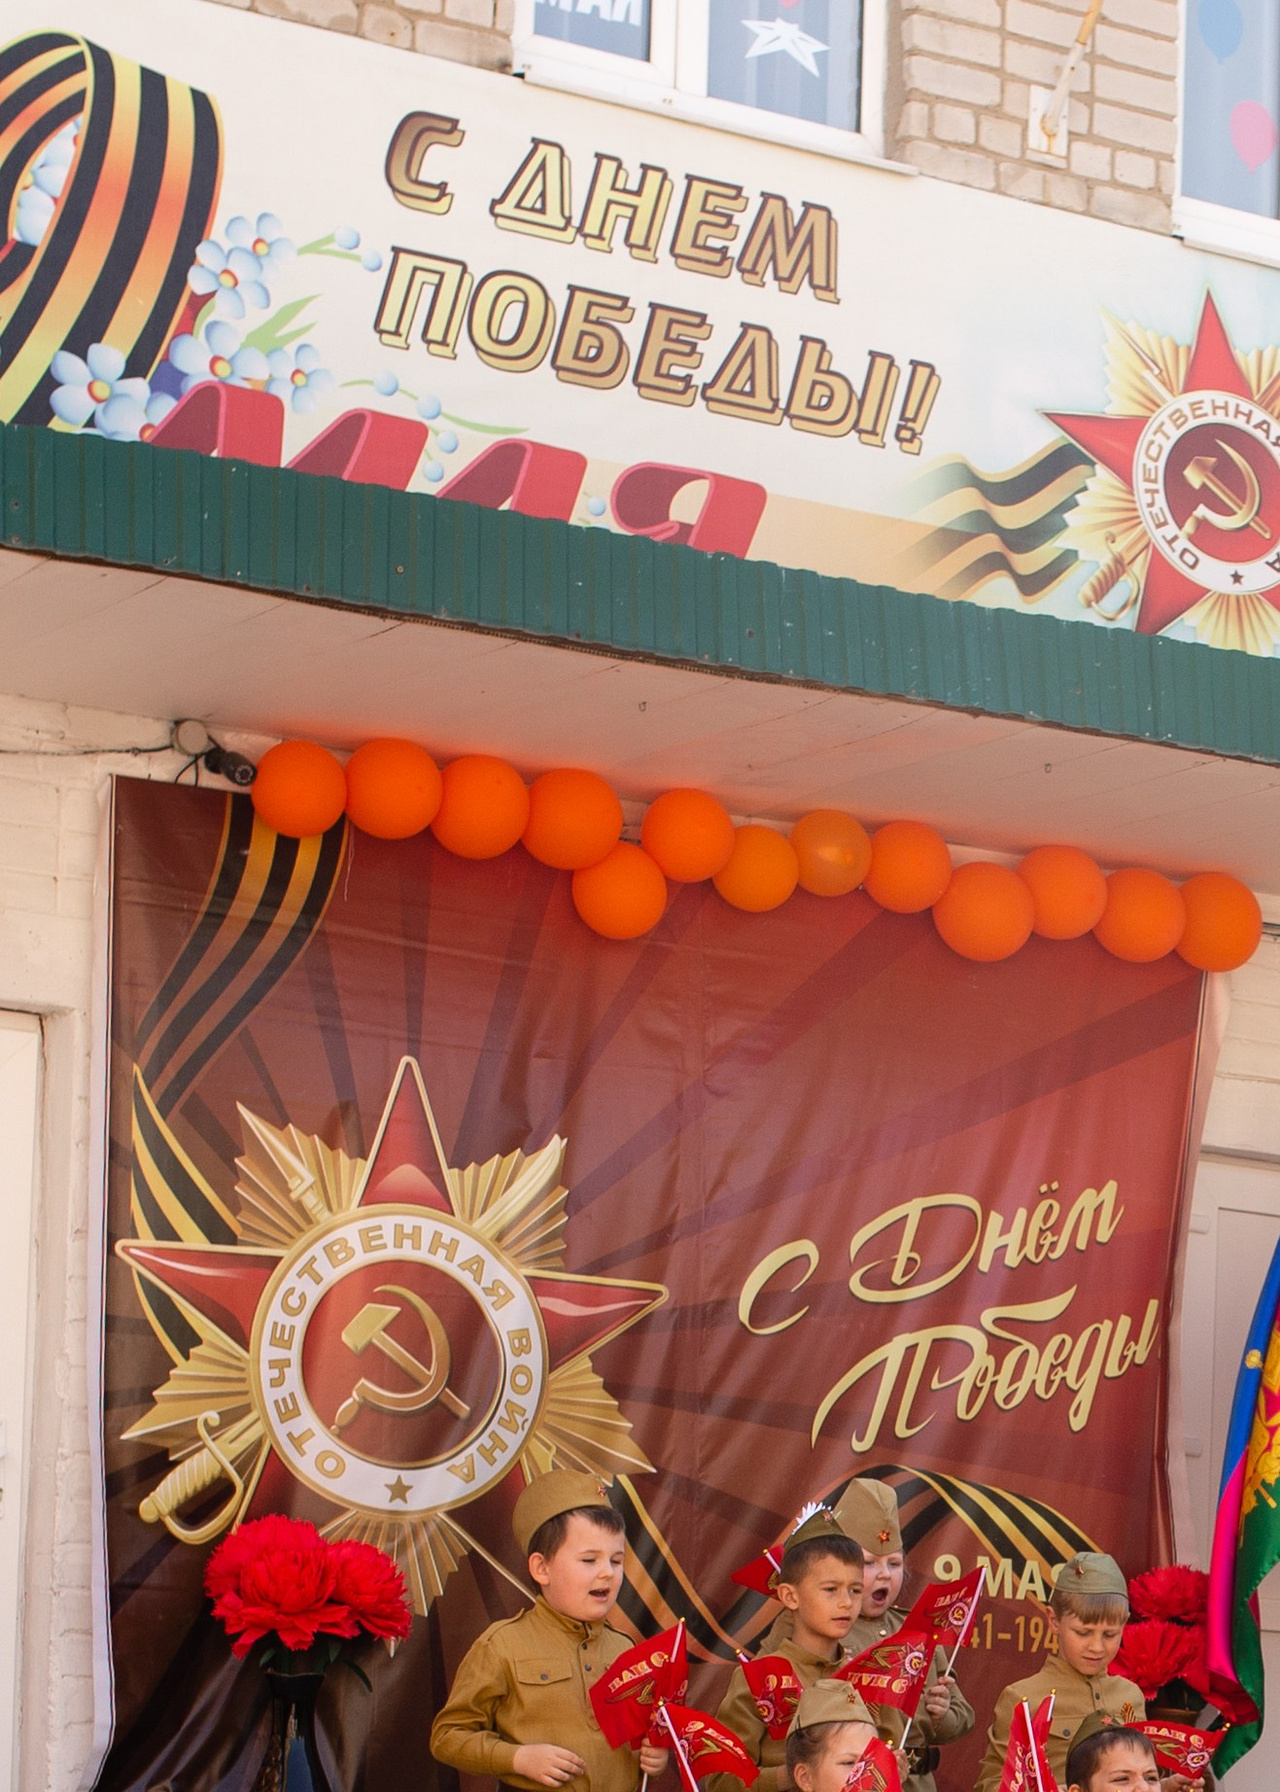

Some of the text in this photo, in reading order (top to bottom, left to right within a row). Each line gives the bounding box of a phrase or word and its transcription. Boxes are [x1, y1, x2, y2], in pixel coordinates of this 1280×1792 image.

[385, 110, 841, 304] С ДНЕМ
[374, 246, 941, 455] ПОБЕДЫ!
[739, 1180, 1124, 1335] С Днём
[268, 1223, 534, 1485] ОТЕЧЕСТВЕННАЯ ВОЙНА
[812, 1284, 1159, 1452] Победы
[976, 1556, 1066, 1602] МА
